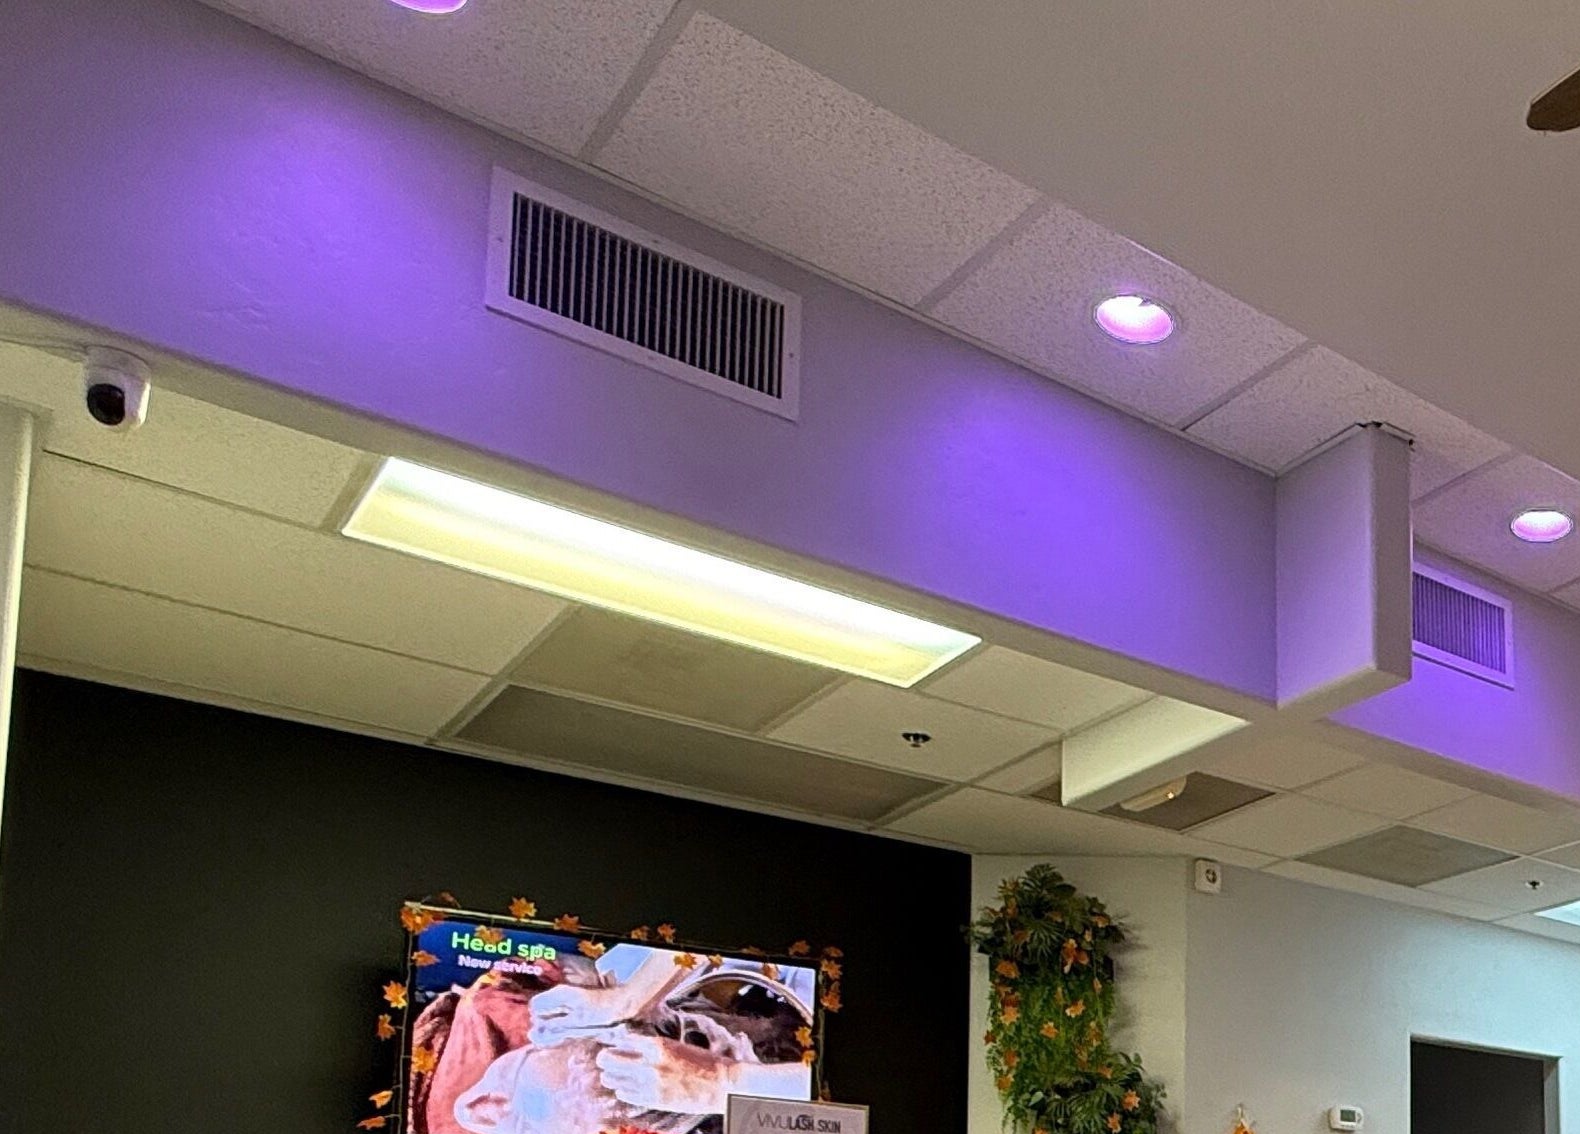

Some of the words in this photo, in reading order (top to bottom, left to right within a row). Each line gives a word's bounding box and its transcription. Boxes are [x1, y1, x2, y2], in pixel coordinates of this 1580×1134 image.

[451, 931, 512, 955] Head
[517, 943, 556, 962] spa
[458, 954, 491, 969] New
[493, 960, 542, 976] service
[817, 1119, 841, 1133] SKIN
